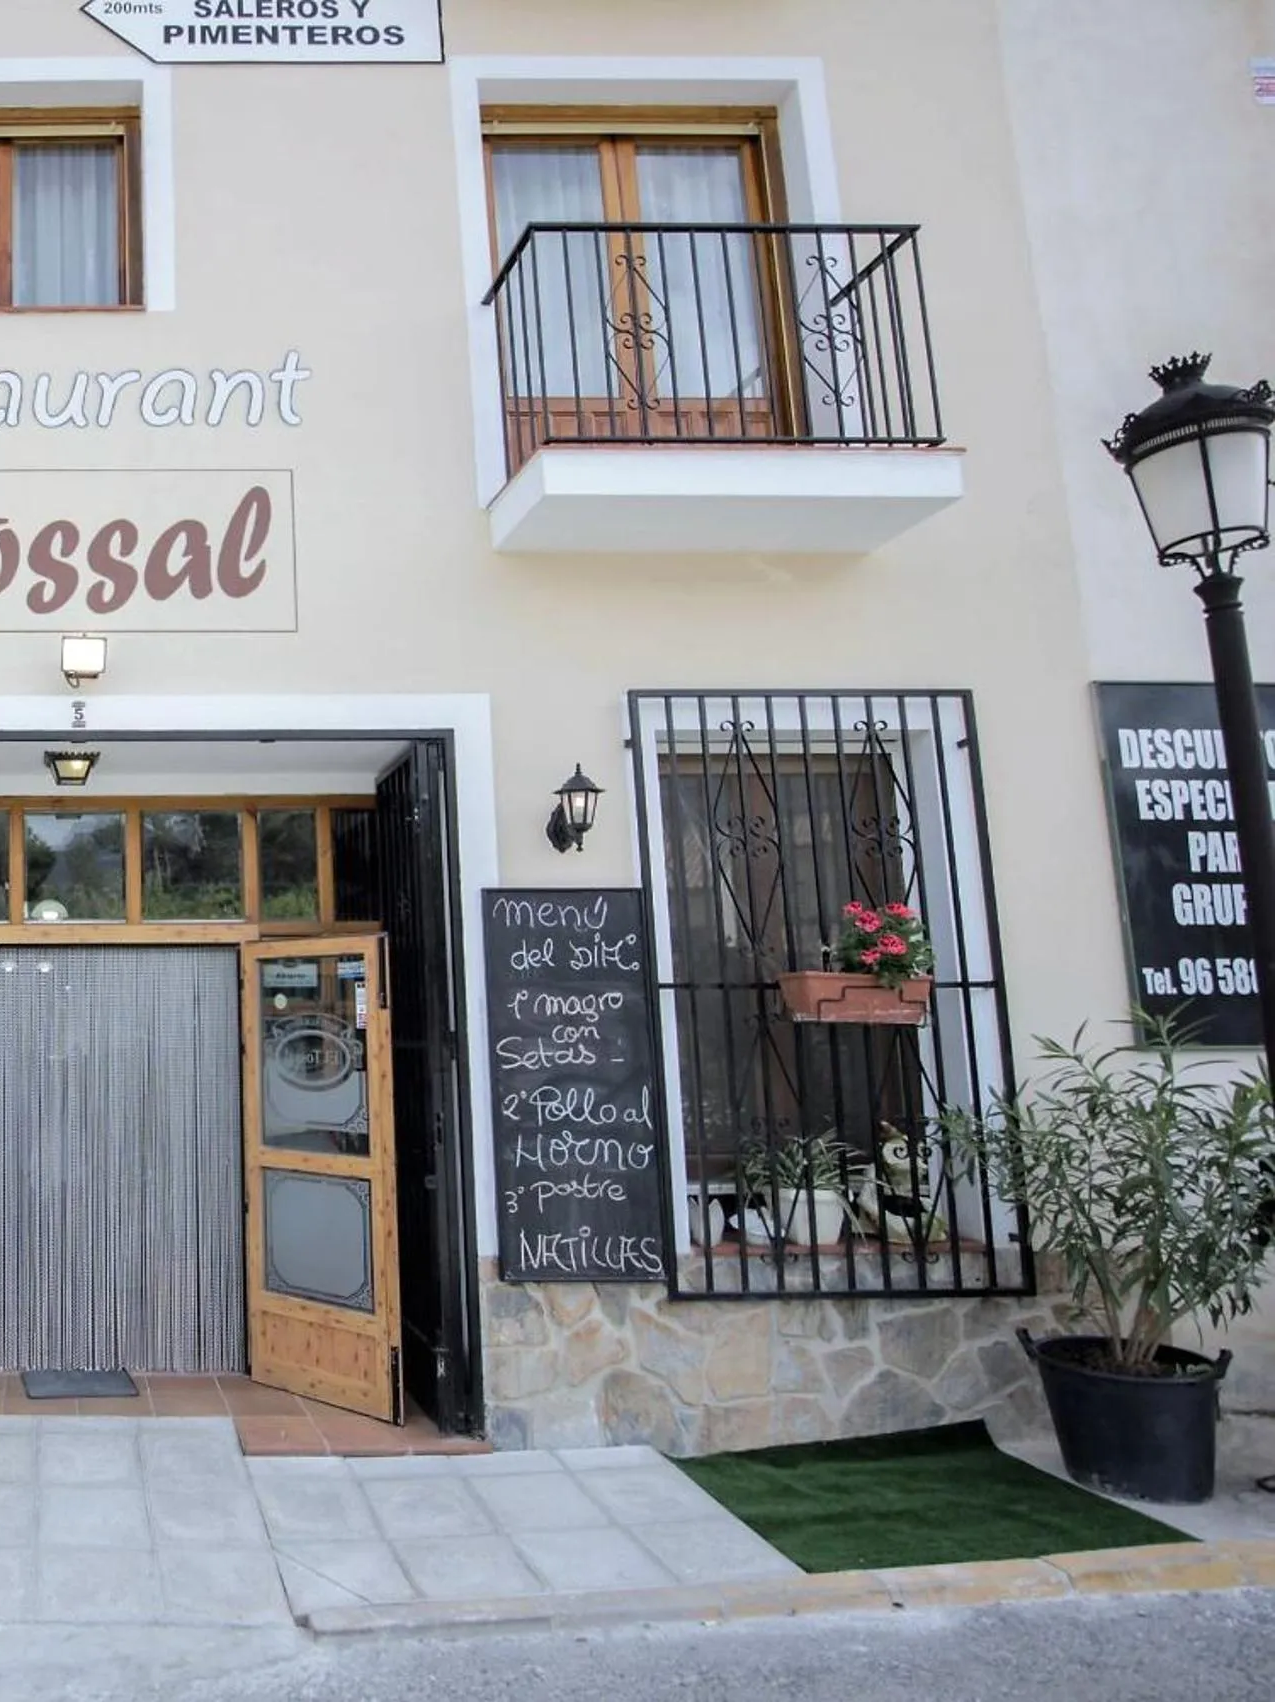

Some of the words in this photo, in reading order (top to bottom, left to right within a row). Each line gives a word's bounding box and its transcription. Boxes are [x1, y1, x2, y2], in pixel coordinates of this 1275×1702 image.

[194, 0, 339, 18] SALEROS
[352, 0, 371, 18] Y
[163, 25, 405, 45] PIMENTEROS
[73, 707, 85, 721] 5
[1187, 830, 1243, 873] PAR
[510, 937, 556, 971] del
[1177, 957, 1214, 996] 96
[551, 1024, 601, 1044] con
[528, 1085, 617, 1128] Pollo
[623, 1084, 654, 1131] al
